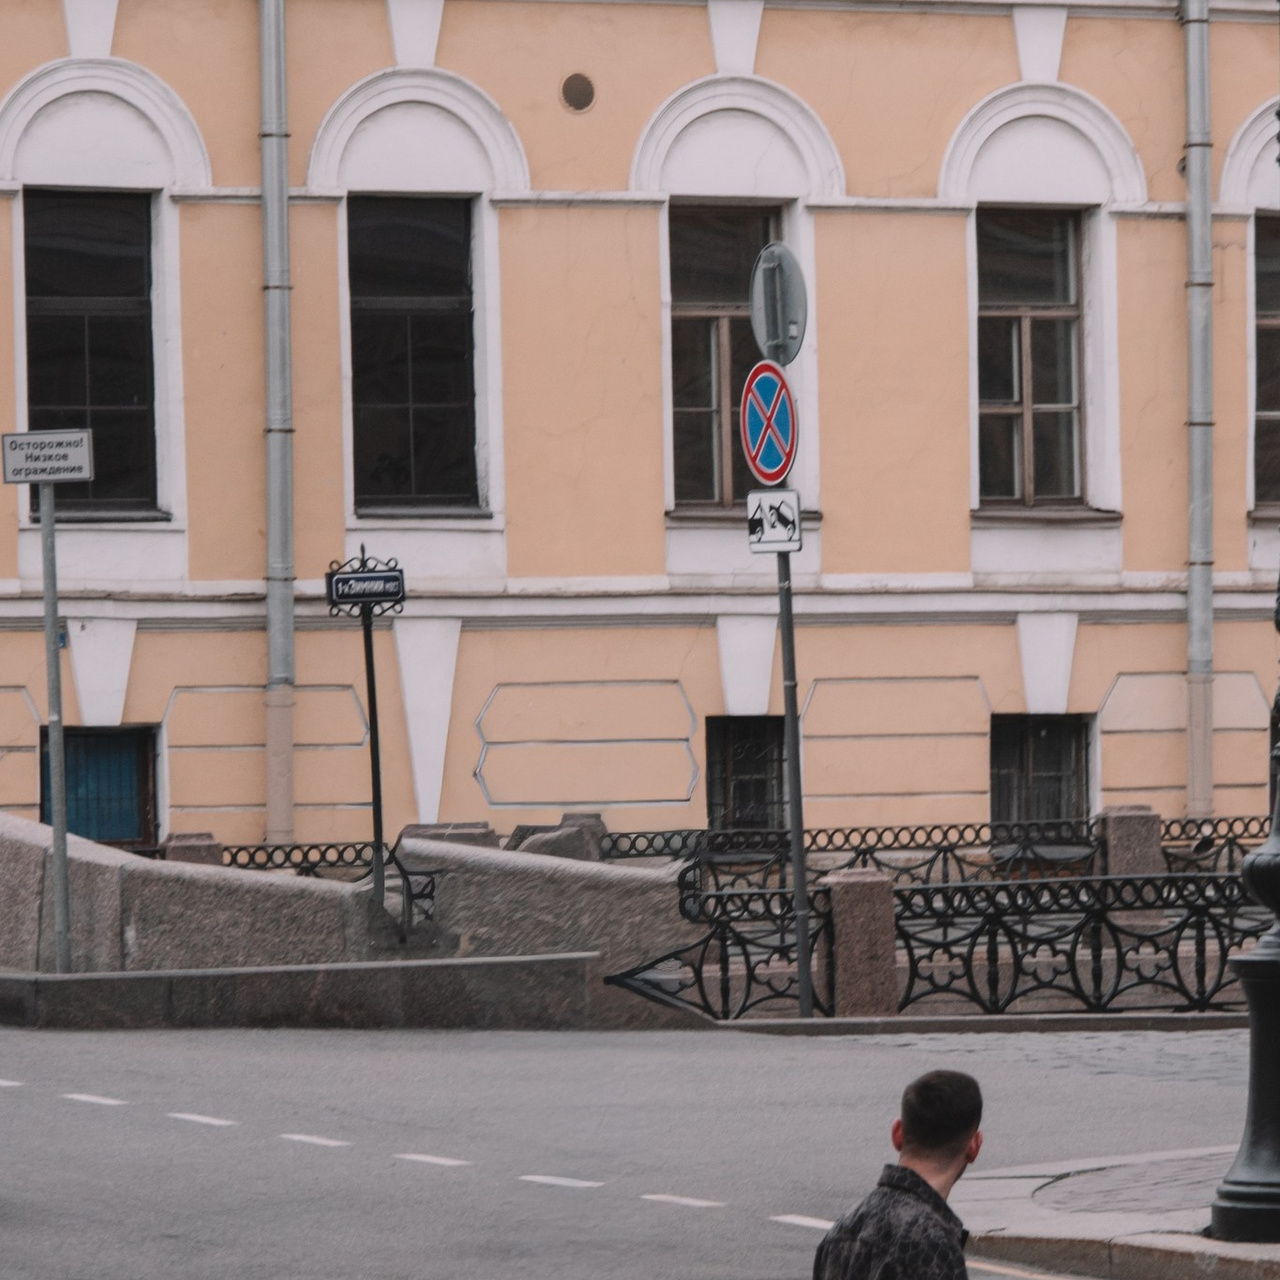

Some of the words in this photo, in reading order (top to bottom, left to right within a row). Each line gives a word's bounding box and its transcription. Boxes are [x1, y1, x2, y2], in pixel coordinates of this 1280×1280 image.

[9, 437, 84, 452] Осторожно!
[25, 452, 69, 463] Низкое
[11, 465, 84, 477] ограждение
